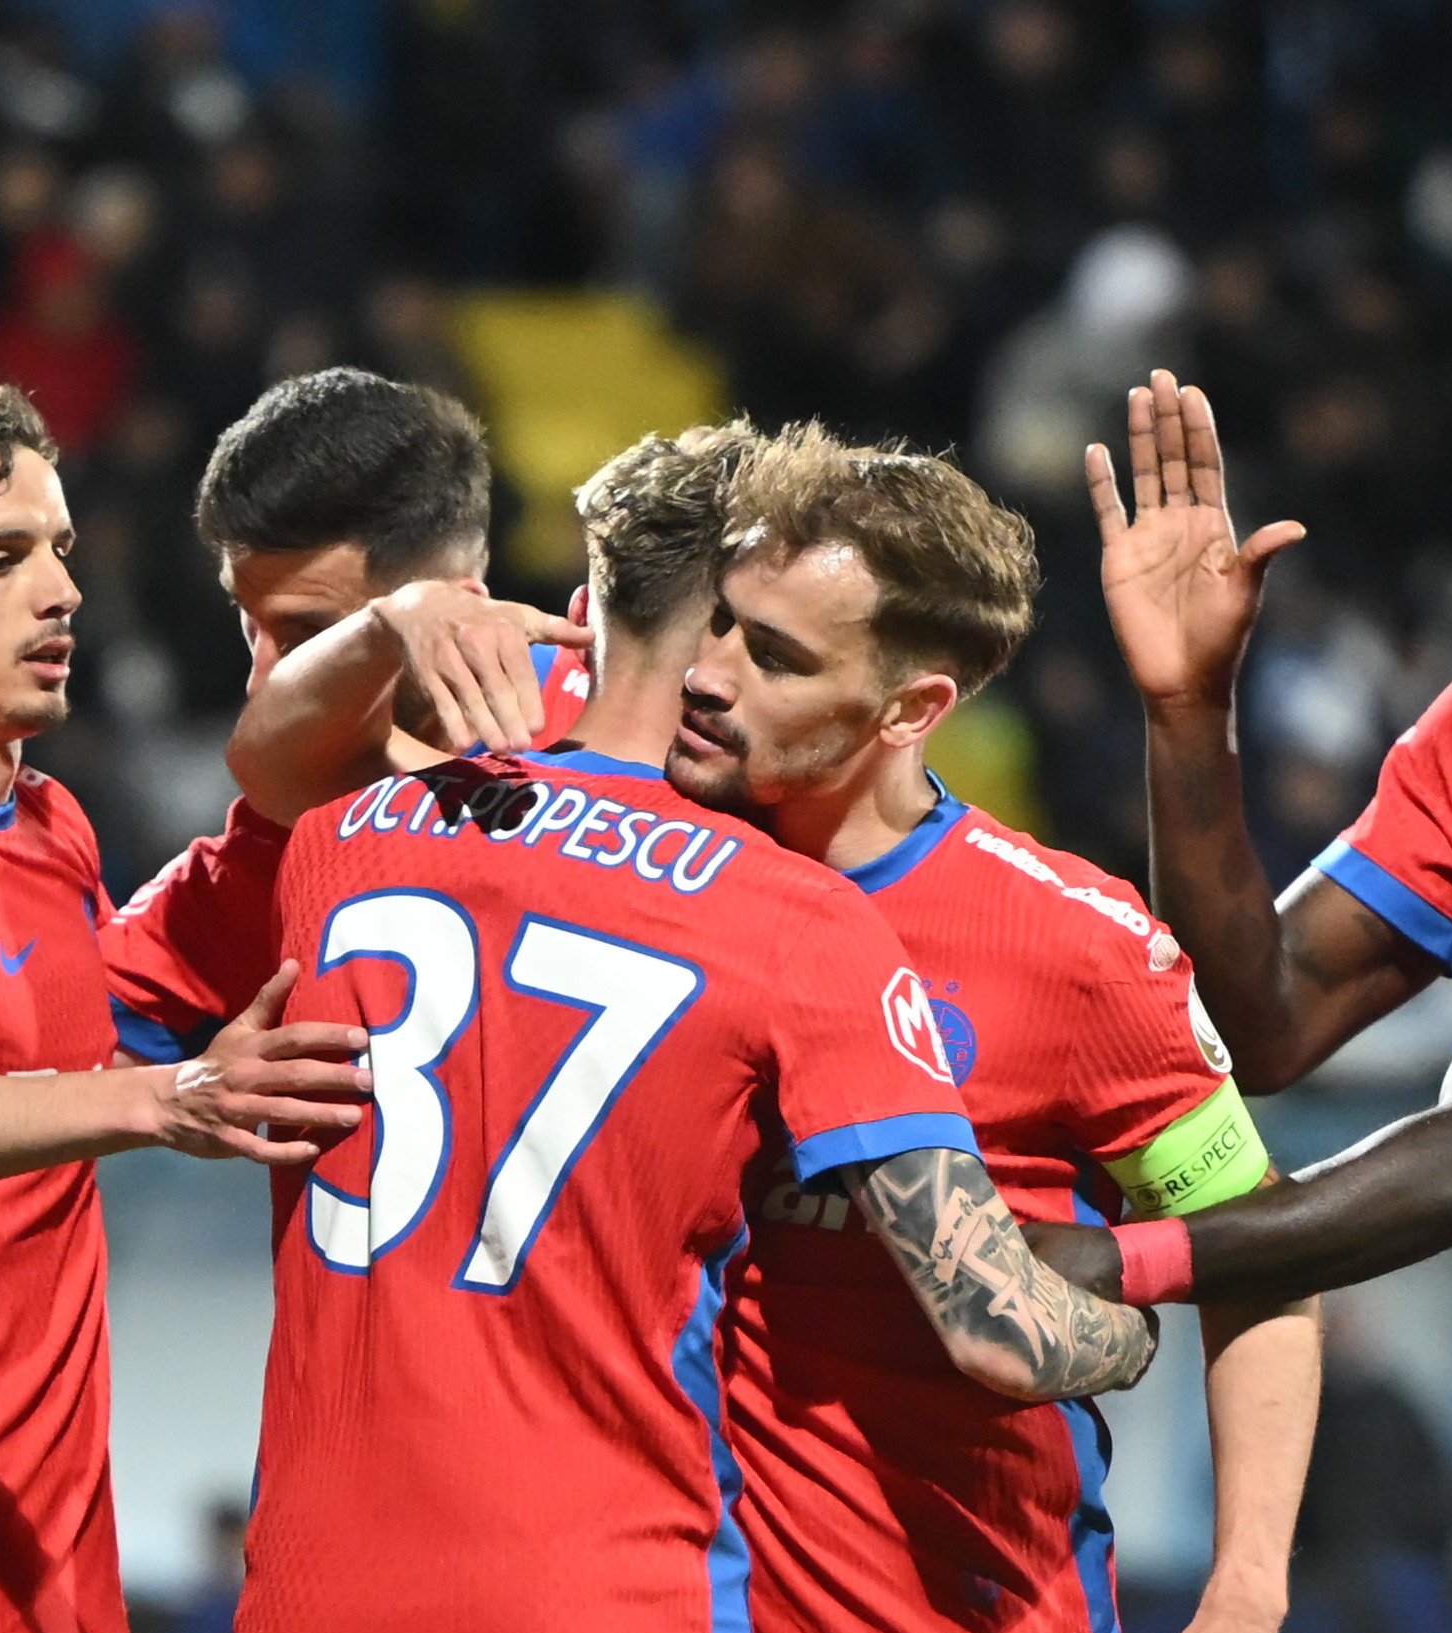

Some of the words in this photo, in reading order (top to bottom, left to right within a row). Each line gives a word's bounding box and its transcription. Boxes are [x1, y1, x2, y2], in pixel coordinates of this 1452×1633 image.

[884, 969, 954, 1082] M
[306, 886, 706, 1297] 37
[1164, 1121, 1242, 1197] RESPECT
